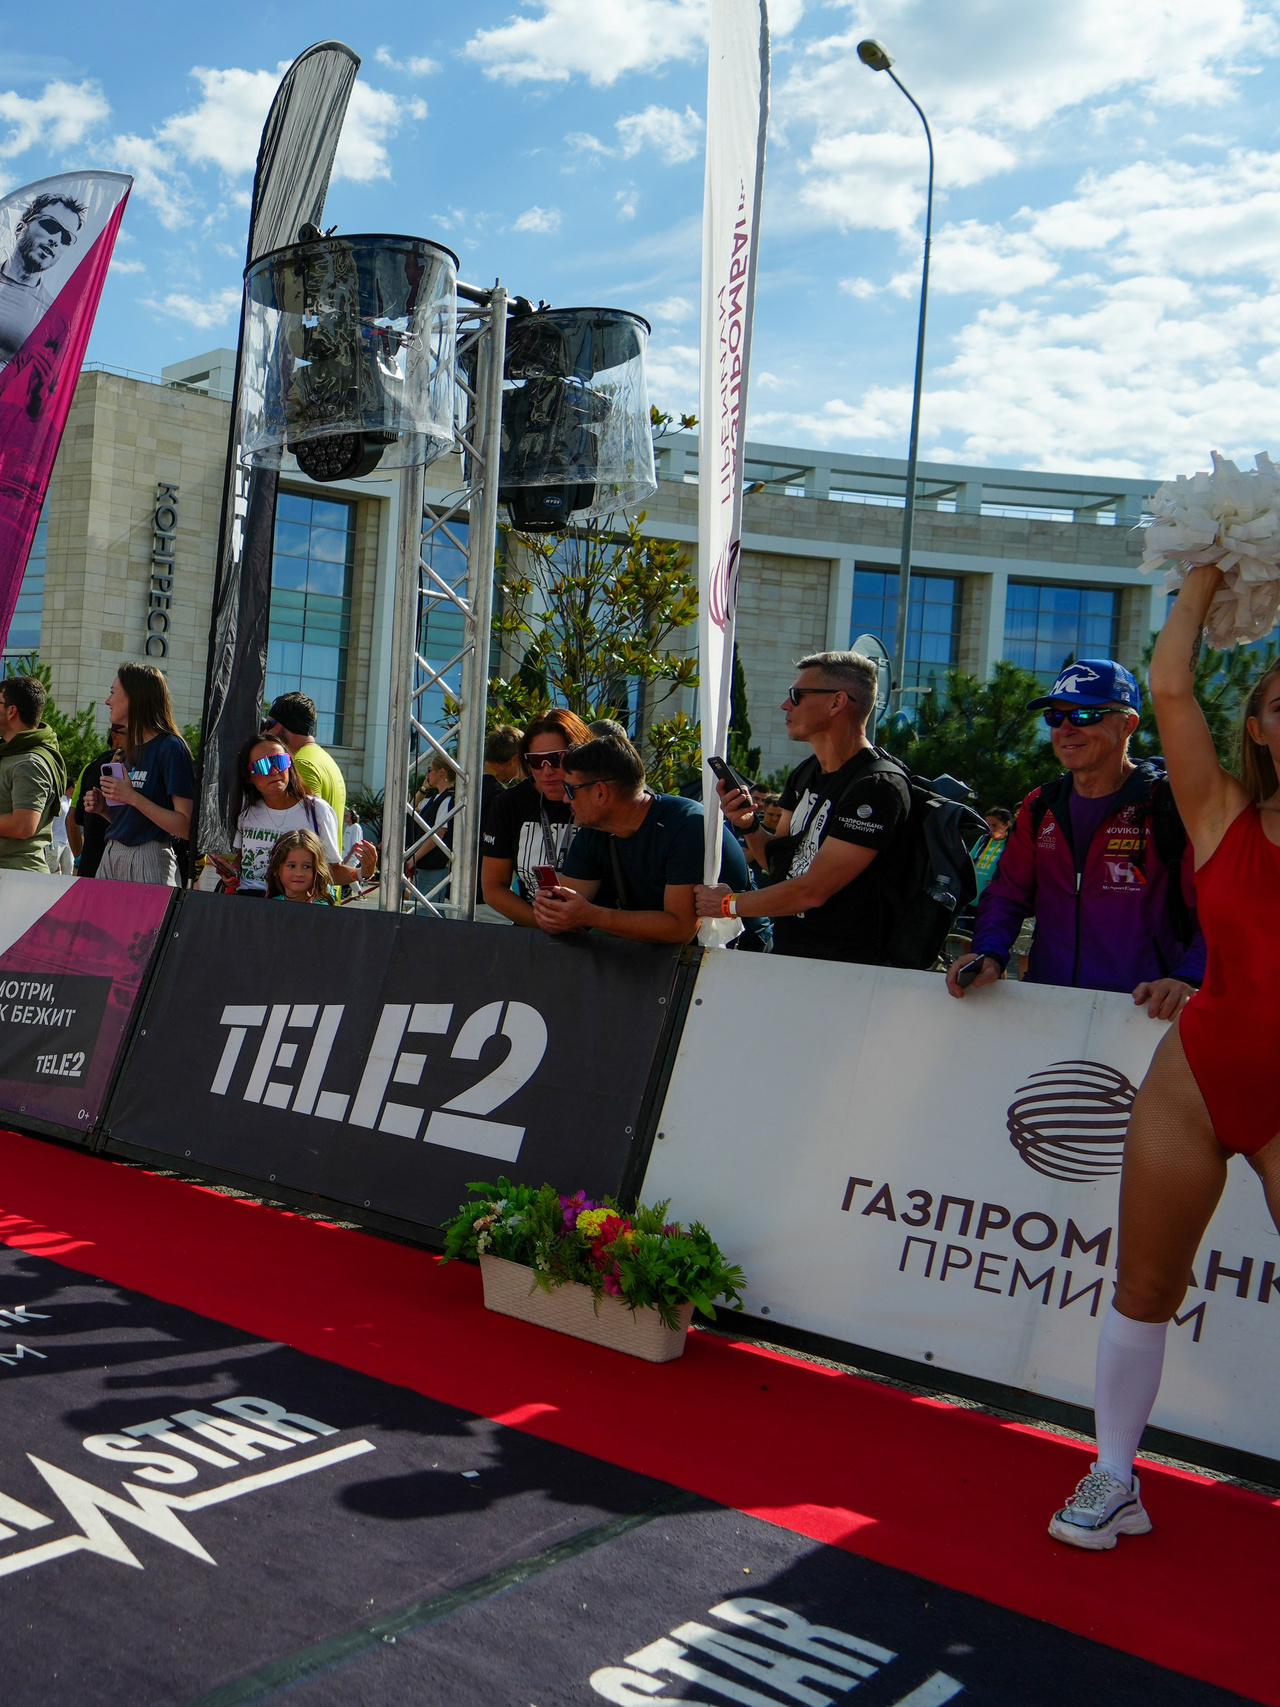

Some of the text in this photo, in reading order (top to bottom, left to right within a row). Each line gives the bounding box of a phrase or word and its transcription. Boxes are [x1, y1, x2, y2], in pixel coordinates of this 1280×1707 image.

[146, 482, 180, 658] КОНГРЕСС
[10, 1005, 76, 1028] БЕЖИТ
[35, 1052, 86, 1078] TELE2
[210, 1000, 549, 1163] TELE2
[77, 1109, 90, 1120] 0+
[898, 1235, 1207, 1343] ПРЕМИМ
[82, 1395, 341, 1485] STAR
